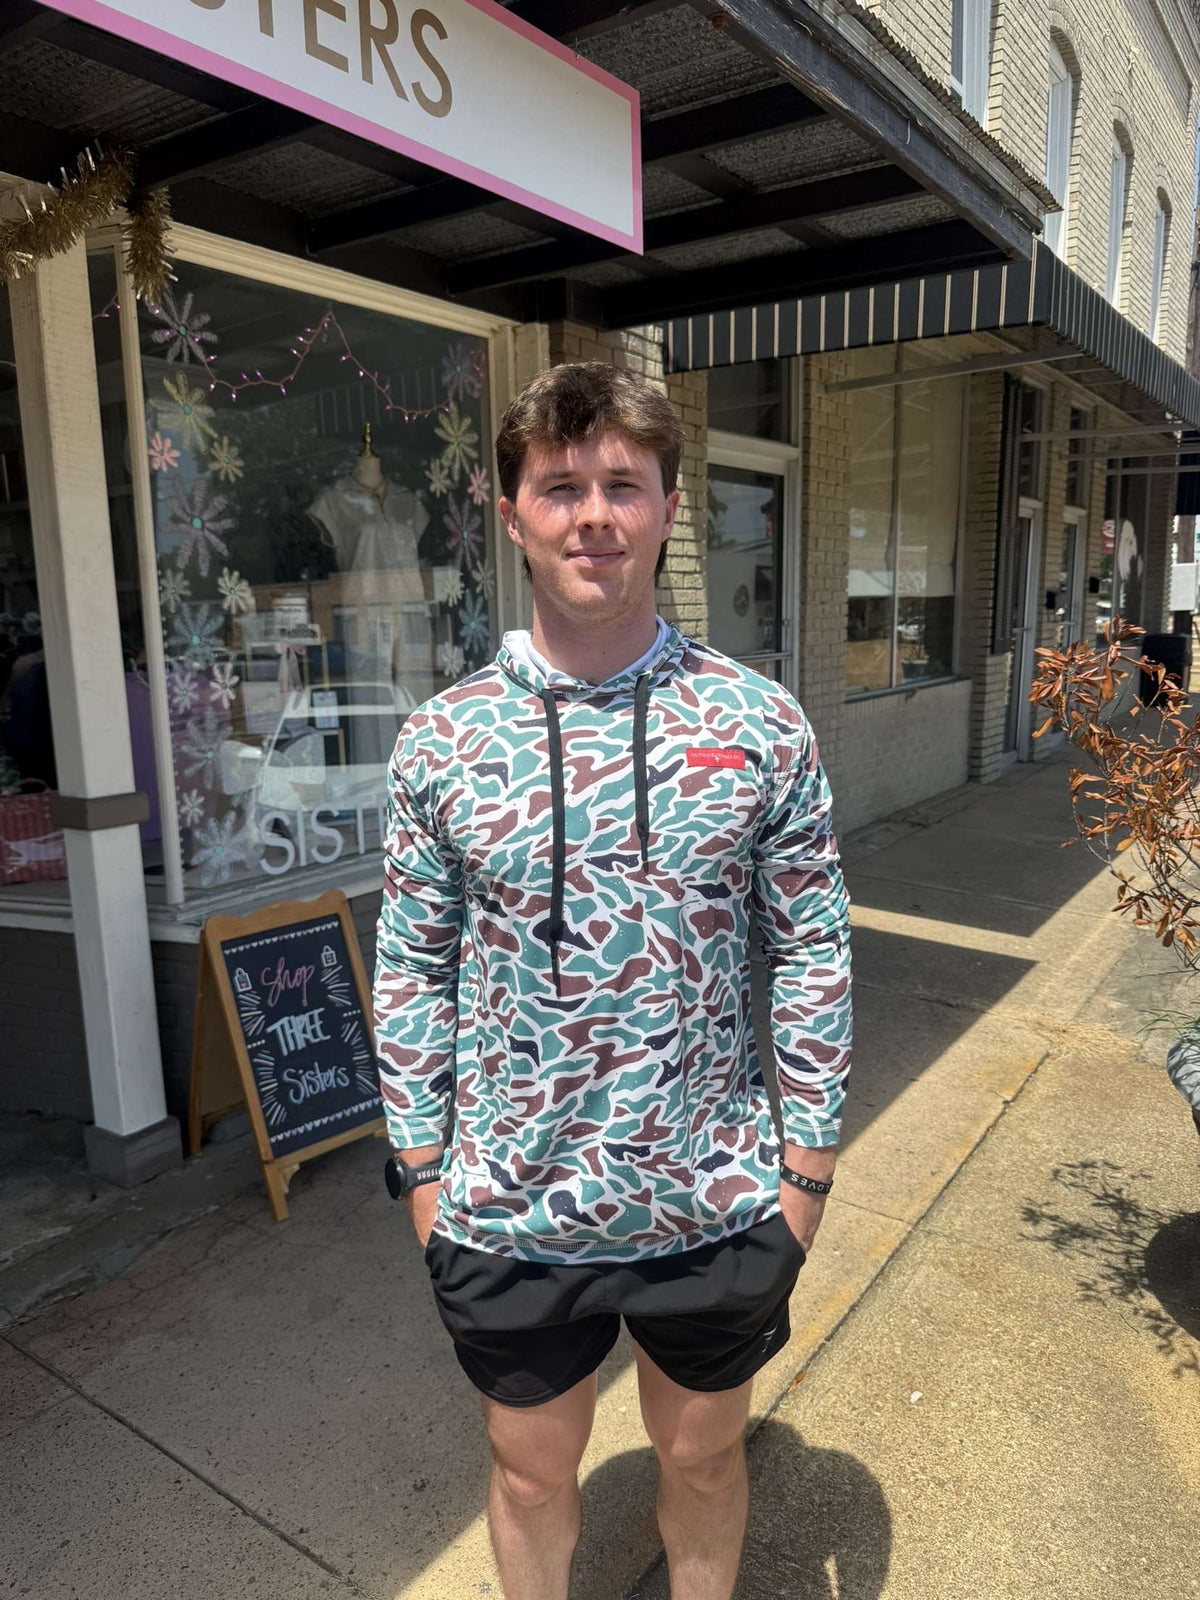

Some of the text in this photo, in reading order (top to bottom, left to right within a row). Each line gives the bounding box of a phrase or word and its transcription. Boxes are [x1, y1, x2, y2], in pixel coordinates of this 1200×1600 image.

[188, 0, 452, 118] ERS
[259, 795, 387, 875] SIST
[260, 957, 316, 1007] Shop
[266, 1007, 332, 1056] THREE
[283, 1062, 350, 1104] Sisters
